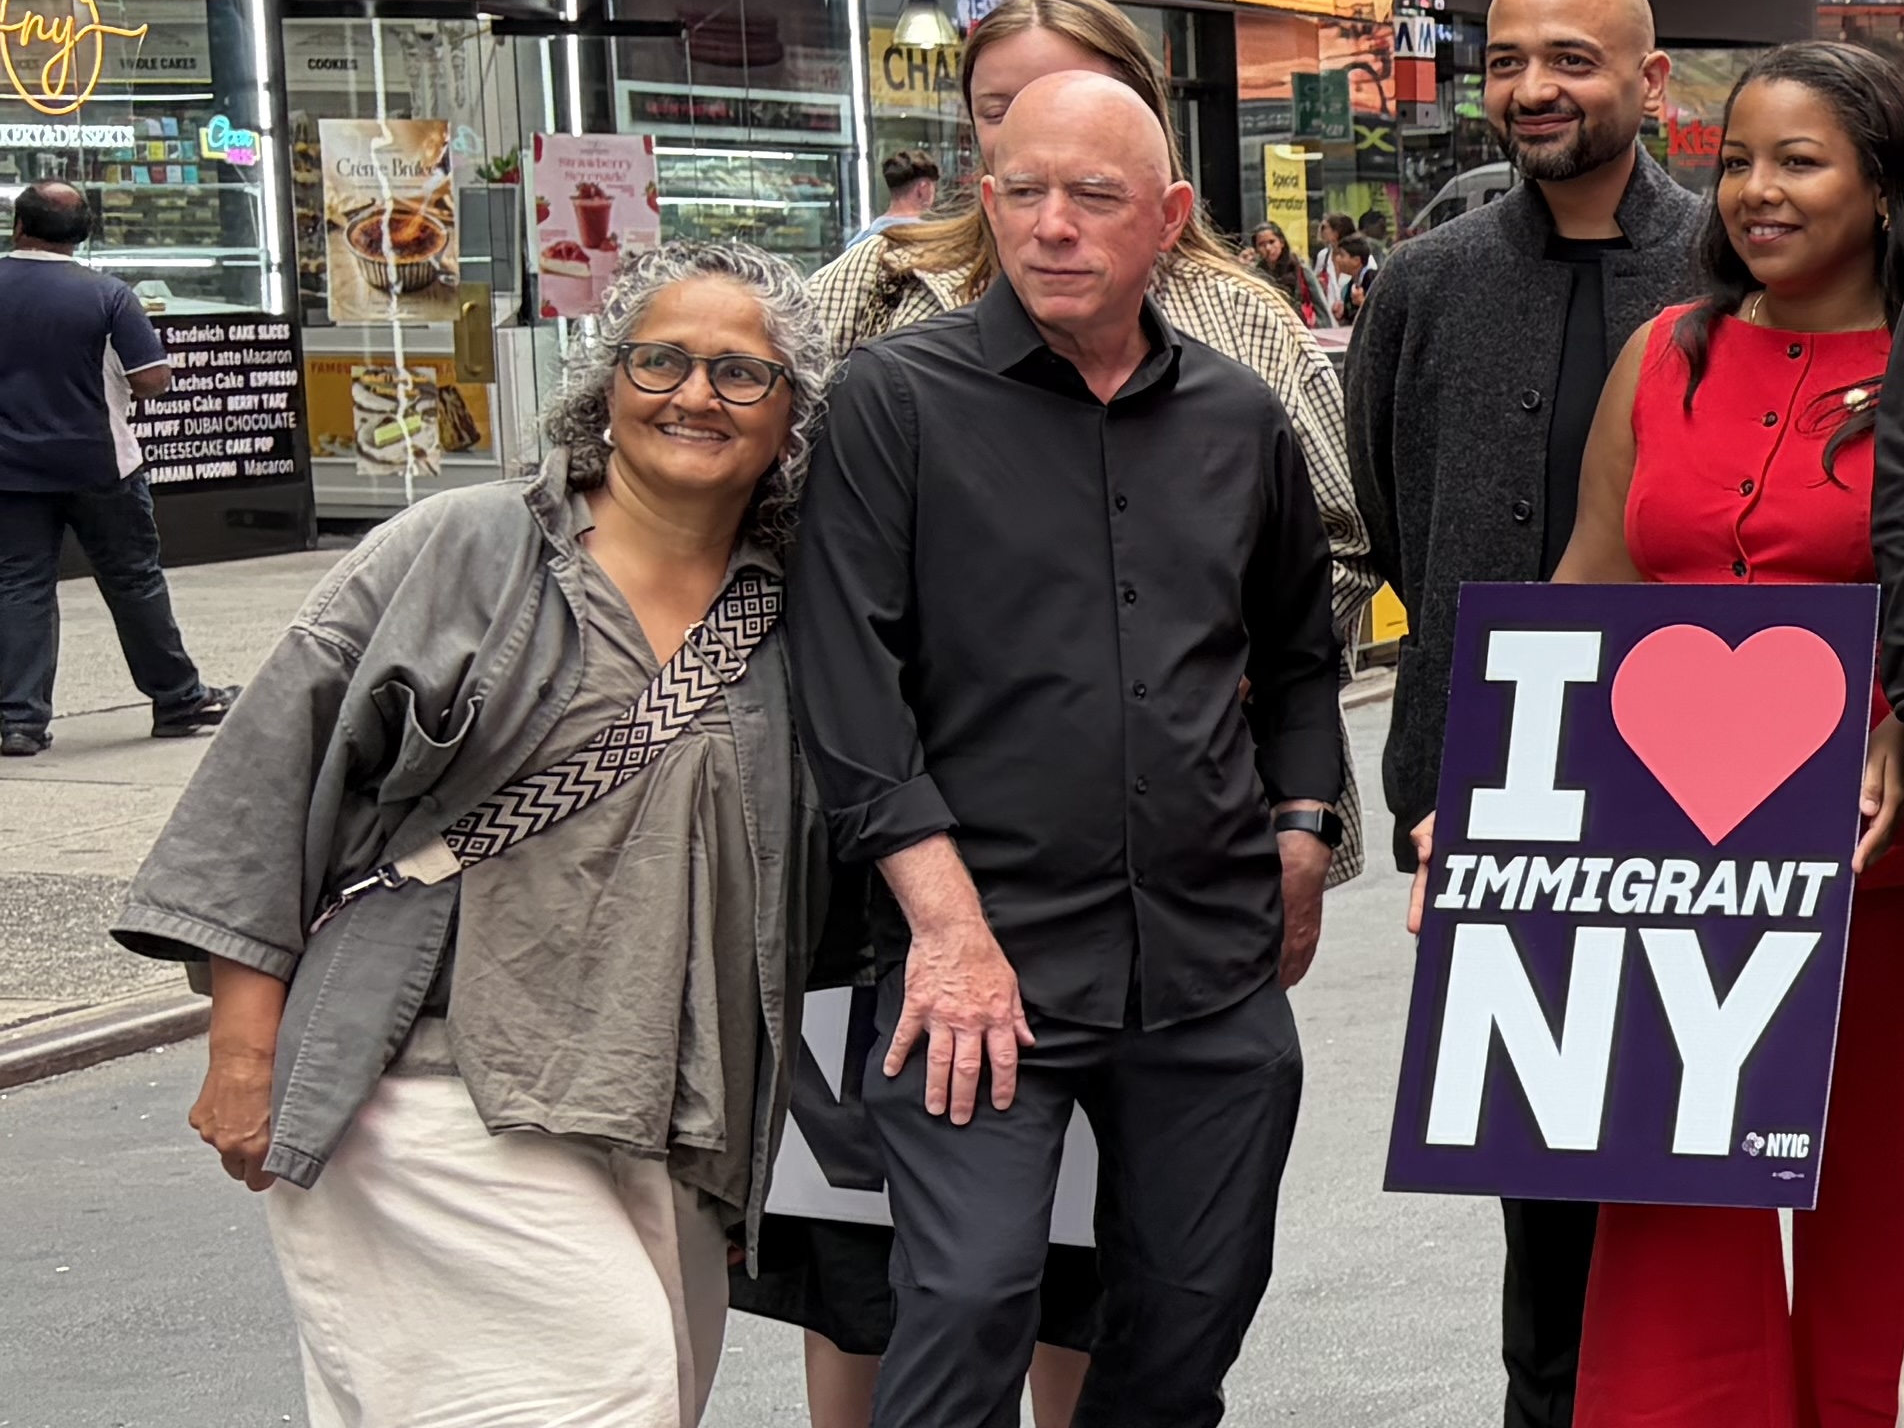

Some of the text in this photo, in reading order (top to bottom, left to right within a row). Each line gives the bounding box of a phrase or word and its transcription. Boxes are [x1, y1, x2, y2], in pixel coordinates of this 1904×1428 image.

[160, 57, 197, 70] CAKES
[207, 114, 254, 148] Open
[166, 324, 225, 345] Sandwich
[228, 324, 257, 342] CAKE
[257, 323, 291, 341] SLICES
[187, 351, 210, 368] POP
[210, 349, 242, 367] Latte
[242, 348, 293, 365] Macaron
[171, 369, 299, 392] Leches Cake ESPRESSO
[144, 398, 191, 417] Mousse
[192, 394, 223, 413] Cake
[153, 419, 181, 438] PUFF
[184, 415, 223, 435] DUBAI
[224, 411, 298, 432] CHOCOLATE
[144, 435, 275, 462] CHEESECAKE CAKE POP
[150, 463, 195, 486] BANANA
[244, 458, 294, 476] Macaron
[1467, 630, 1602, 842] I
[1434, 854, 1839, 917] IMMIGRANT
[1425, 923, 1822, 1156] NY
[1766, 1132, 1810, 1159] NYIC
